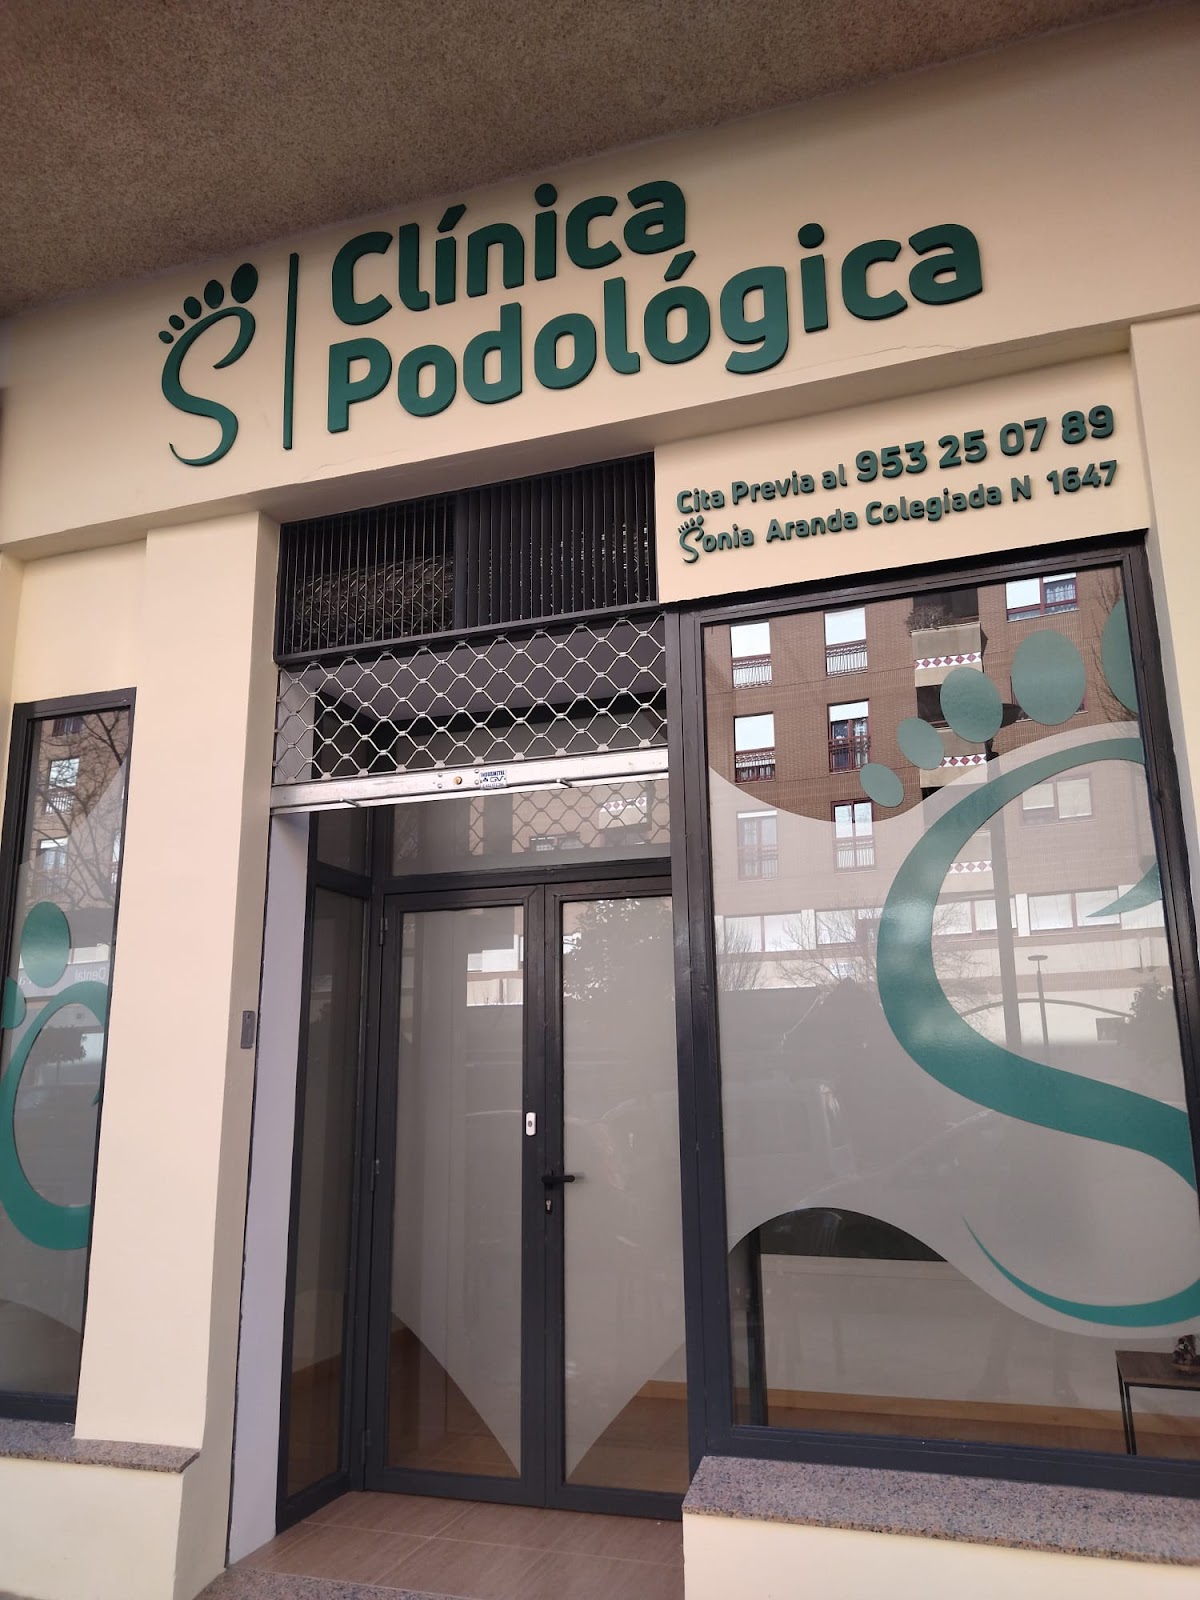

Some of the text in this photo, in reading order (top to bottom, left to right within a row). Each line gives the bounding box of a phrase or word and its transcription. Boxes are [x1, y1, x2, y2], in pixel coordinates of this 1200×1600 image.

[330, 180, 686, 326] Clínica
[326, 223, 984, 433] Podológica
[676, 405, 1115, 514] Cita Previa al 953 25 07 89
[677, 460, 1118, 564] Sonia Aranda Colegiada N 1647
